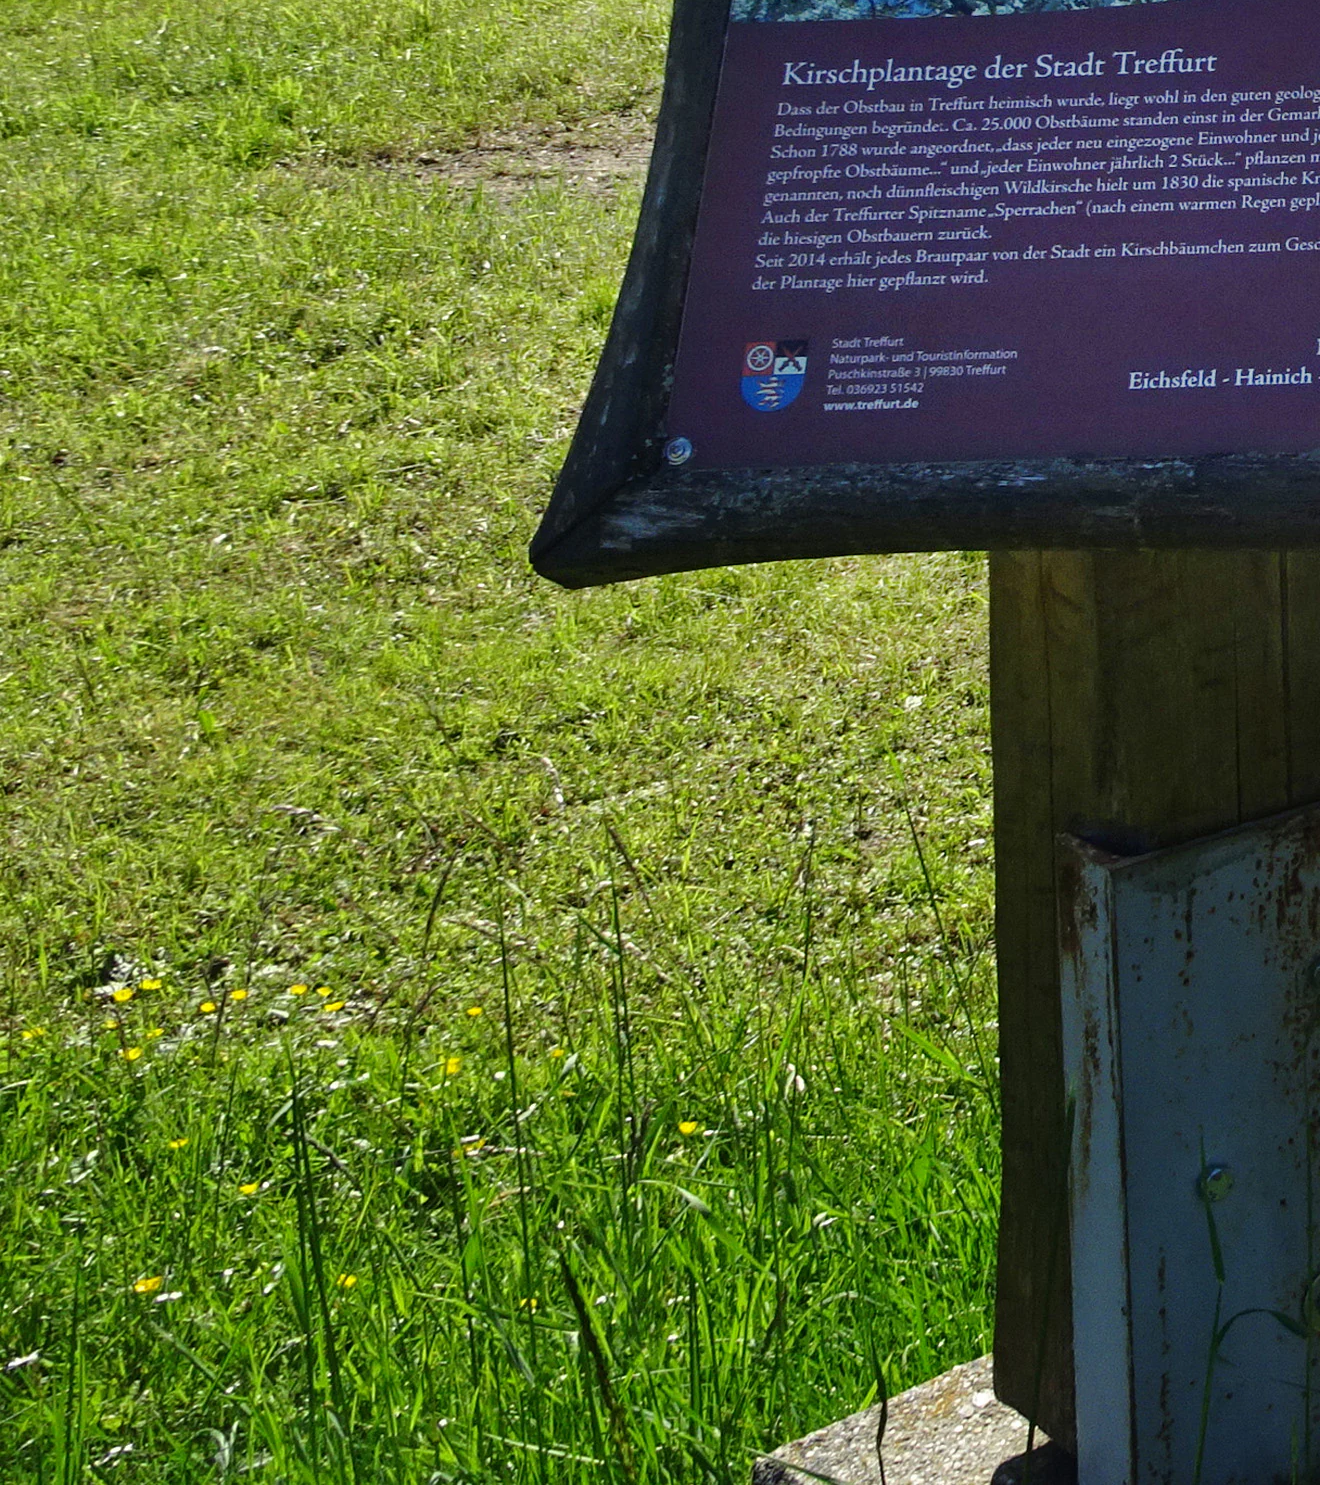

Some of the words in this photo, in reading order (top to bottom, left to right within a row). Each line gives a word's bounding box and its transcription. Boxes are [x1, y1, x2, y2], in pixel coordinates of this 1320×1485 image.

[782, 58, 977, 91] Kirschplantage
[984, 54, 1026, 79] der
[1034, 51, 1106, 78] Stadt
[1112, 48, 1218, 75] Treffurt
[777, 102, 812, 116] Dass
[816, 101, 840, 115] der
[843, 99, 905, 114] Obstbau
[909, 99, 923, 112] in
[928, 96, 985, 111] Treffurt
[988, 94, 1052, 109] heimisch
[1057, 92, 1105, 107] wurde,
[1108, 92, 1140, 110] liegt
[1143, 90, 1179, 104] wohl
[1183, 90, 1197, 103] in
[1200, 88, 1227, 102] den
[1230, 91, 1271, 106] guten
[774, 123, 867, 140] Bedingungen
[952, 118, 977, 131] Ca.
[981, 116, 1032, 131] 25.000
[1035, 114, 1119, 129] Obstbäume
[1123, 111, 1179, 126] standen
[1183, 111, 1218, 124] einst
[1222, 110, 1236, 123] in
[1239, 108, 1264, 122] der
[770, 144, 816, 158] Schon
[821, 143, 858, 157] 1788
[861, 141, 907, 156] wurde
[910, 139, 997, 158] angeordnet,
[1034, 136, 1073, 155] jeder
[1075, 140, 1102, 149] neu
[1106, 135, 1194, 152] eingezogene
[1198, 129, 1278, 145] Einwohner
[1281, 127, 1312, 145] und
[766, 164, 841, 185] gepfropfte
[950, 160, 981, 175] und
[1027, 157, 1108, 174] Einwohner
[1107, 154, 1164, 174] jährlich
[1168, 154, 1178, 167] 2
[1245, 150, 1306, 170] pflanzen
[763, 191, 843, 207] genannten,
[847, 185, 882, 199] noch
[886, 182, 999, 200] dünnfleischigen
[1004, 178, 1093, 194] Wildkirsche
[1096, 177, 1129, 192] hielt
[1132, 181, 1156, 190] um
[1162, 175, 1199, 189] 1830
[1202, 174, 1224, 188] die
[1227, 171, 1298, 192] spanische
[761, 209, 800, 223] Auch
[804, 209, 829, 222] der
[833, 206, 905, 221] Treffurter
[908, 205, 987, 224] Spitzname
[1086, 199, 1126, 217] (nach
[1130, 199, 1174, 212] einem
[1179, 200, 1236, 210] warmen
[1241, 195, 1286, 213] Regen
[758, 232, 780, 245] die
[783, 231, 842, 249] hiesigen
[847, 228, 933, 243] Obstbauern
[937, 225, 992, 240] zurück.
[754, 254, 784, 268] Seit
[788, 253, 826, 267] 2014
[829, 251, 874, 269] erhält
[872, 249, 911, 269] jedes
[915, 249, 989, 266] Brautpaar
[992, 251, 1019, 260] von
[1022, 245, 1047, 260] der
[1050, 244, 1091, 259] Stadt
[1094, 244, 1116, 257] ein
[1121, 239, 1244, 257] Kirschbäumchen
[1248, 242, 1281, 253] zum
[751, 276, 776, 290] der
[780, 275, 843, 293] Plantage
[846, 273, 876, 287] hier
[878, 271, 947, 291] gepflanzt
[950, 269, 988, 284] wird.
[832, 338, 861, 348] Stadt
[863, 336, 904, 347] Treffurt
[830, 352, 889, 365] Naturpark-
[892, 351, 915, 362] und
[916, 349, 1018, 361] Touristinformation
[828, 367, 912, 379] Puschkinstraße
[914, 367, 921, 377] 3
[929, 366, 964, 376] 99830
[966, 364, 1007, 375] Treffurt
[1128, 369, 1217, 389] Eichsfeld
[1234, 366, 1312, 386] Hainich
[826, 385, 844, 395] Tel.
[846, 384, 887, 394] 036923
[890, 382, 924, 393] 51542
[823, 398, 919, 411] www.treffurt.de
